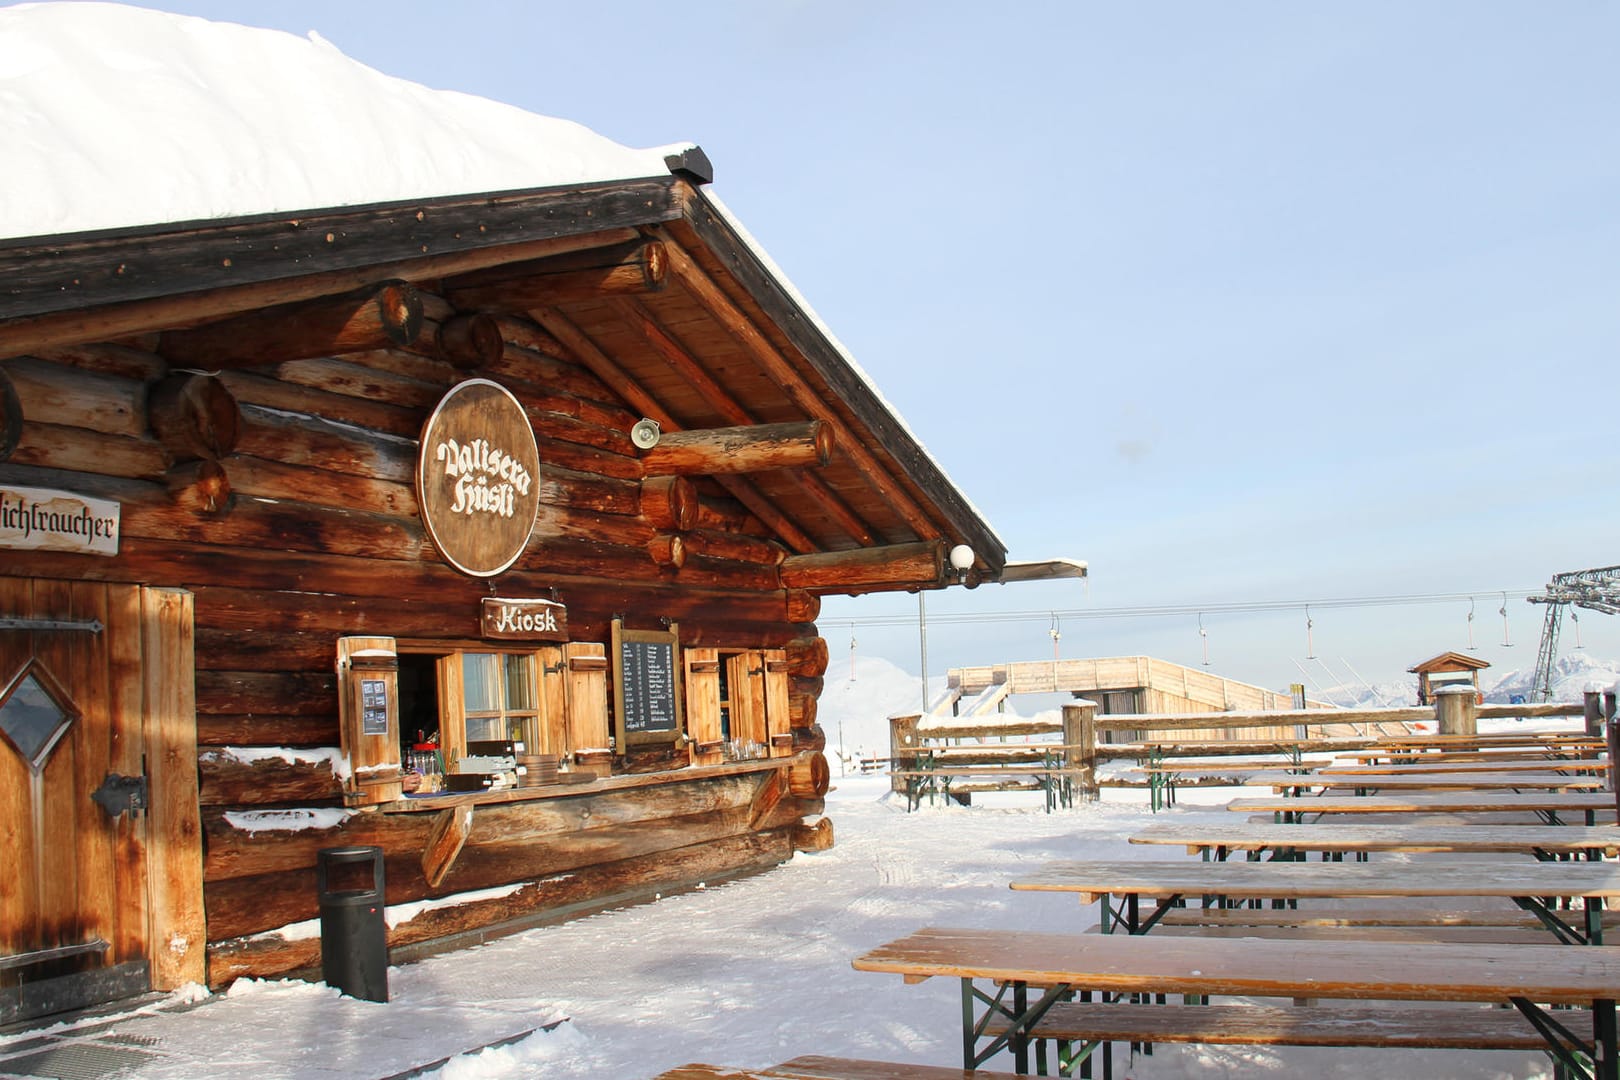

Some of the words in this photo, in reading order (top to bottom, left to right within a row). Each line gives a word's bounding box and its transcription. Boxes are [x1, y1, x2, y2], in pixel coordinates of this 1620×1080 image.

[437, 438, 531, 496] Valisera
[0, 492, 114, 545] ichtraucher
[450, 472, 514, 518] Hüsli
[496, 605, 558, 632] Kiosk
